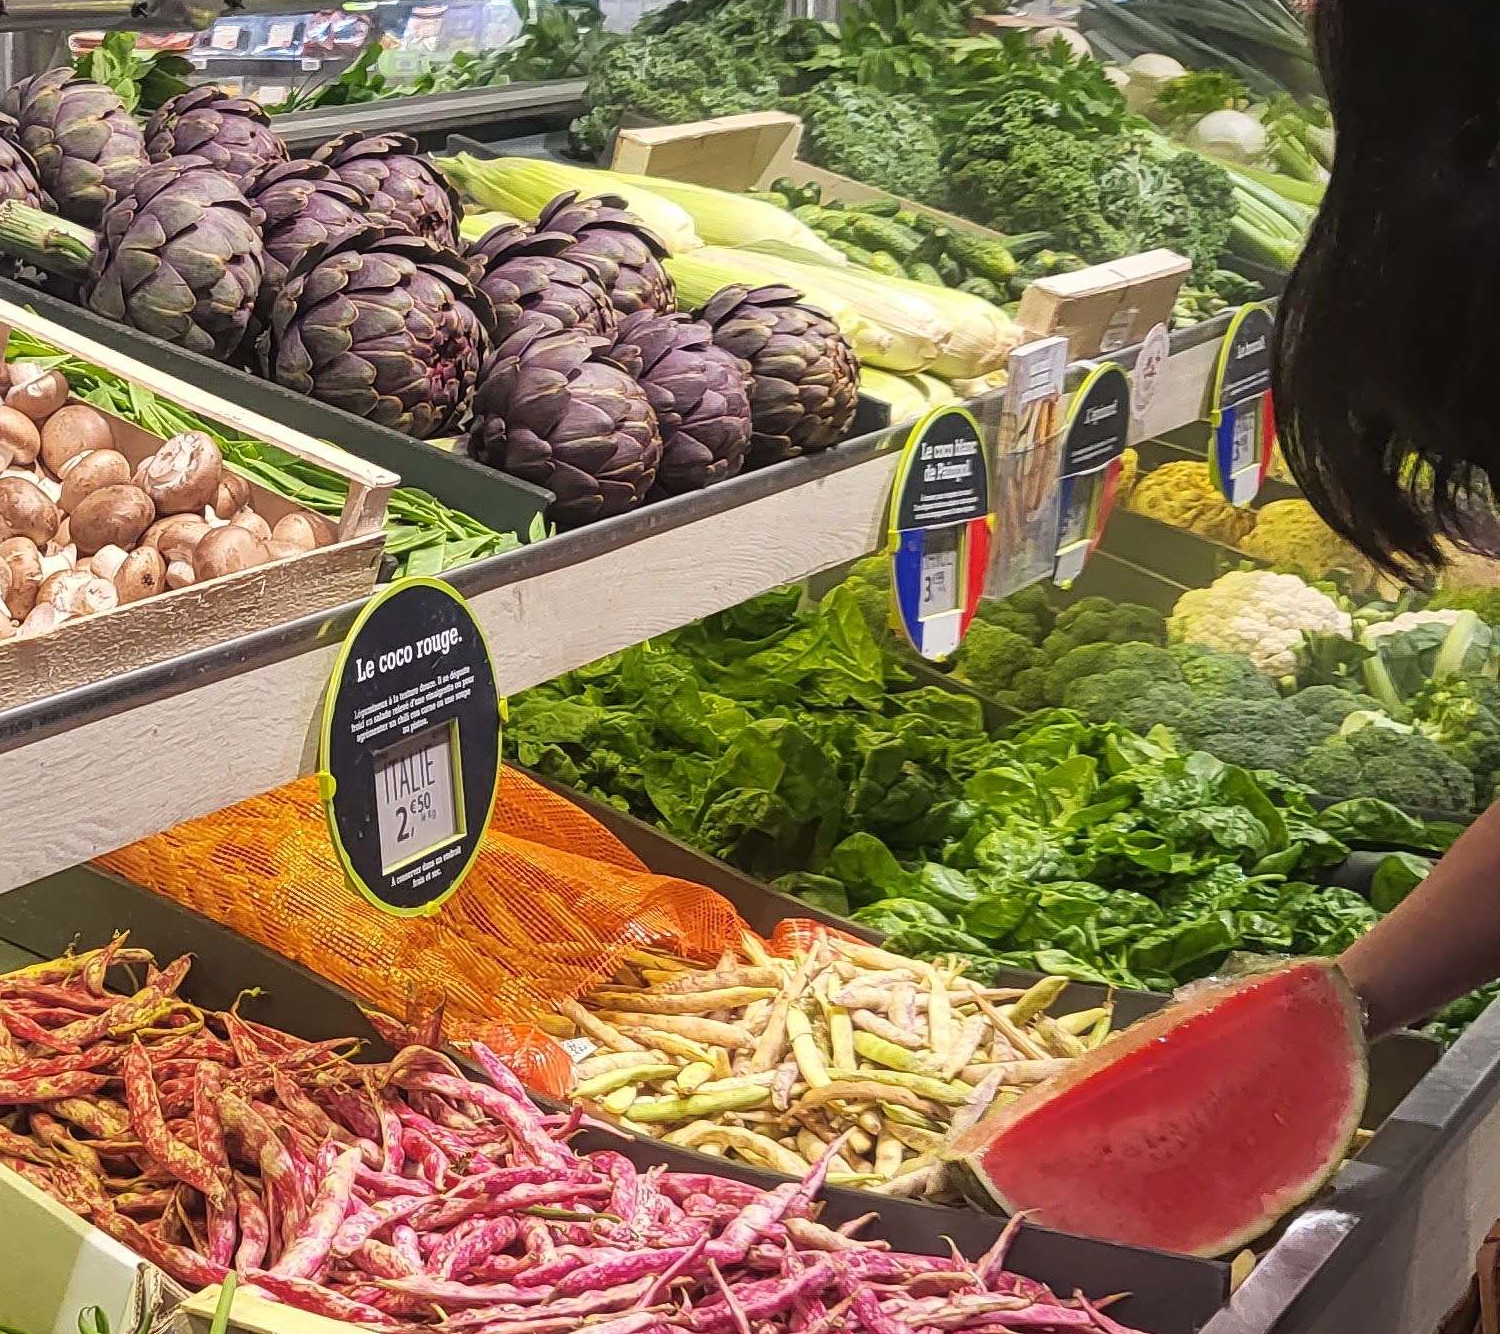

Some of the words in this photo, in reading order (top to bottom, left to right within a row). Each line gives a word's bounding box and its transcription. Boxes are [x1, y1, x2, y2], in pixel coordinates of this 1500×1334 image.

[356, 658, 375, 683] Le
[379, 645, 413, 673] coco
[416, 627, 463, 659] rouge.
[384, 747, 435, 805] ITALIE
